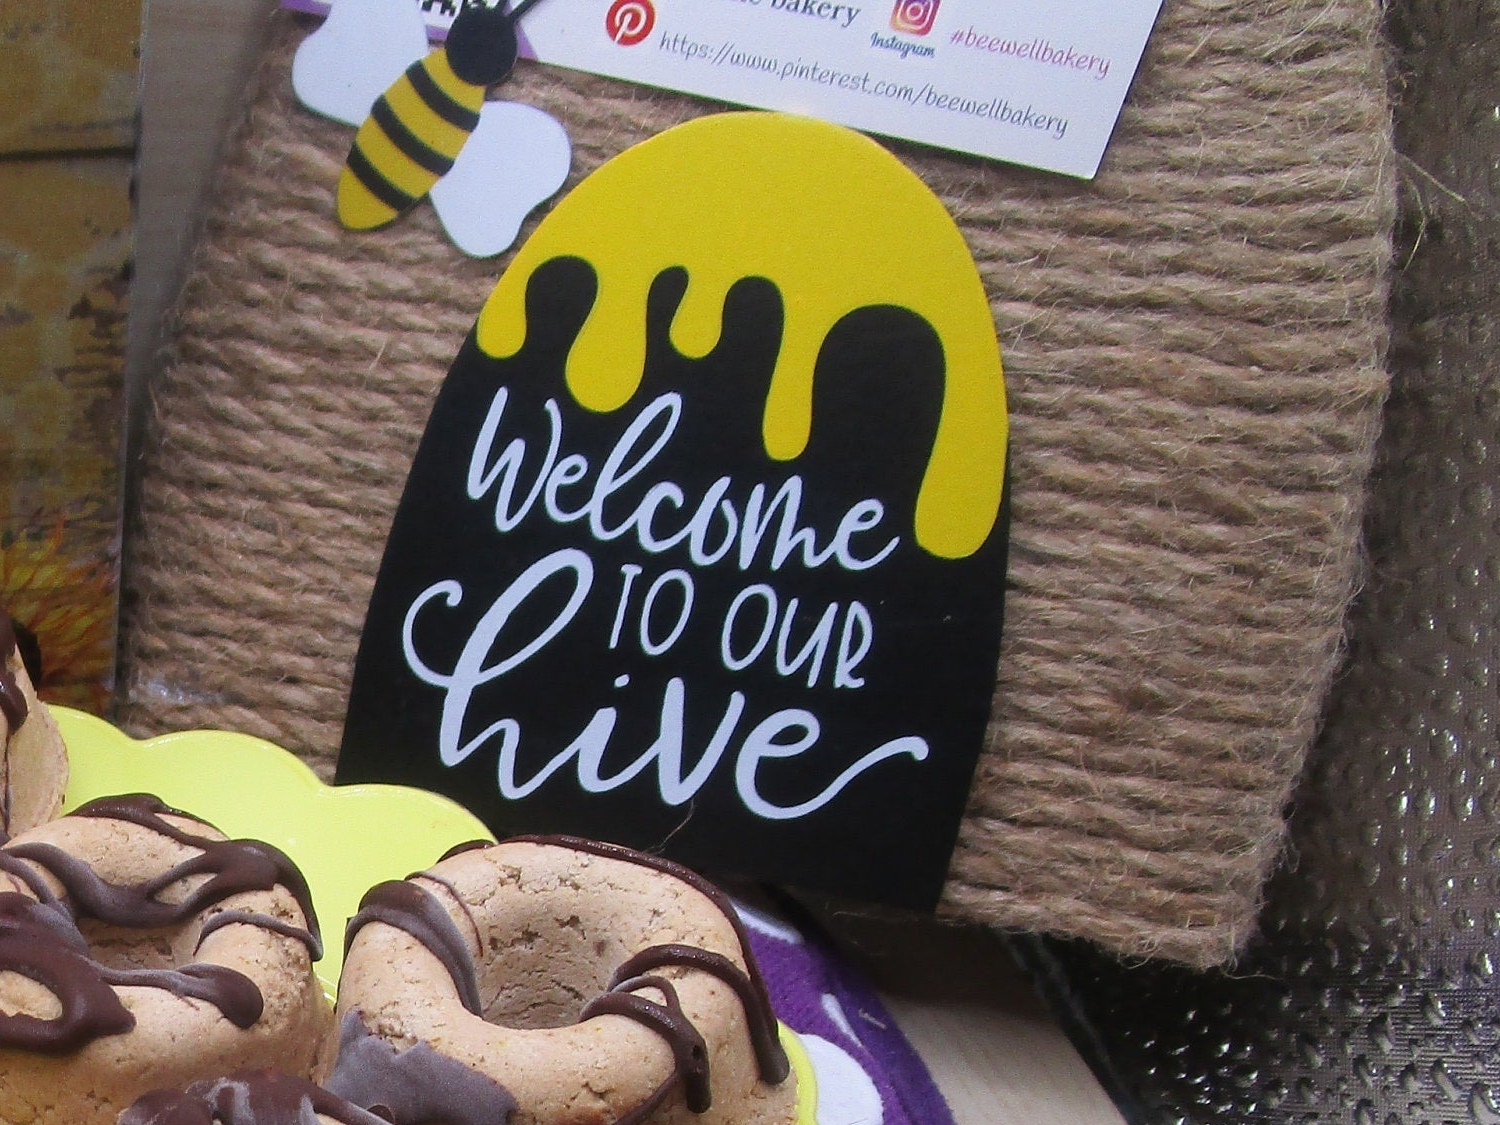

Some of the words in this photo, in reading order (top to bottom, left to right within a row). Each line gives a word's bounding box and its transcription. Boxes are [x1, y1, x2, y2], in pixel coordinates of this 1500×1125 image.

[658, 30, 1069, 141] https://www.pinterest.com/beewellbakery
[870, 31, 936, 59] Instagram
[950, 24, 1111, 81] #beewellbakery
[467, 386, 899, 571] Welcome
[402, 547, 929, 820] hive
[608, 563, 695, 656] TO
[720, 583, 873, 689] OUR
